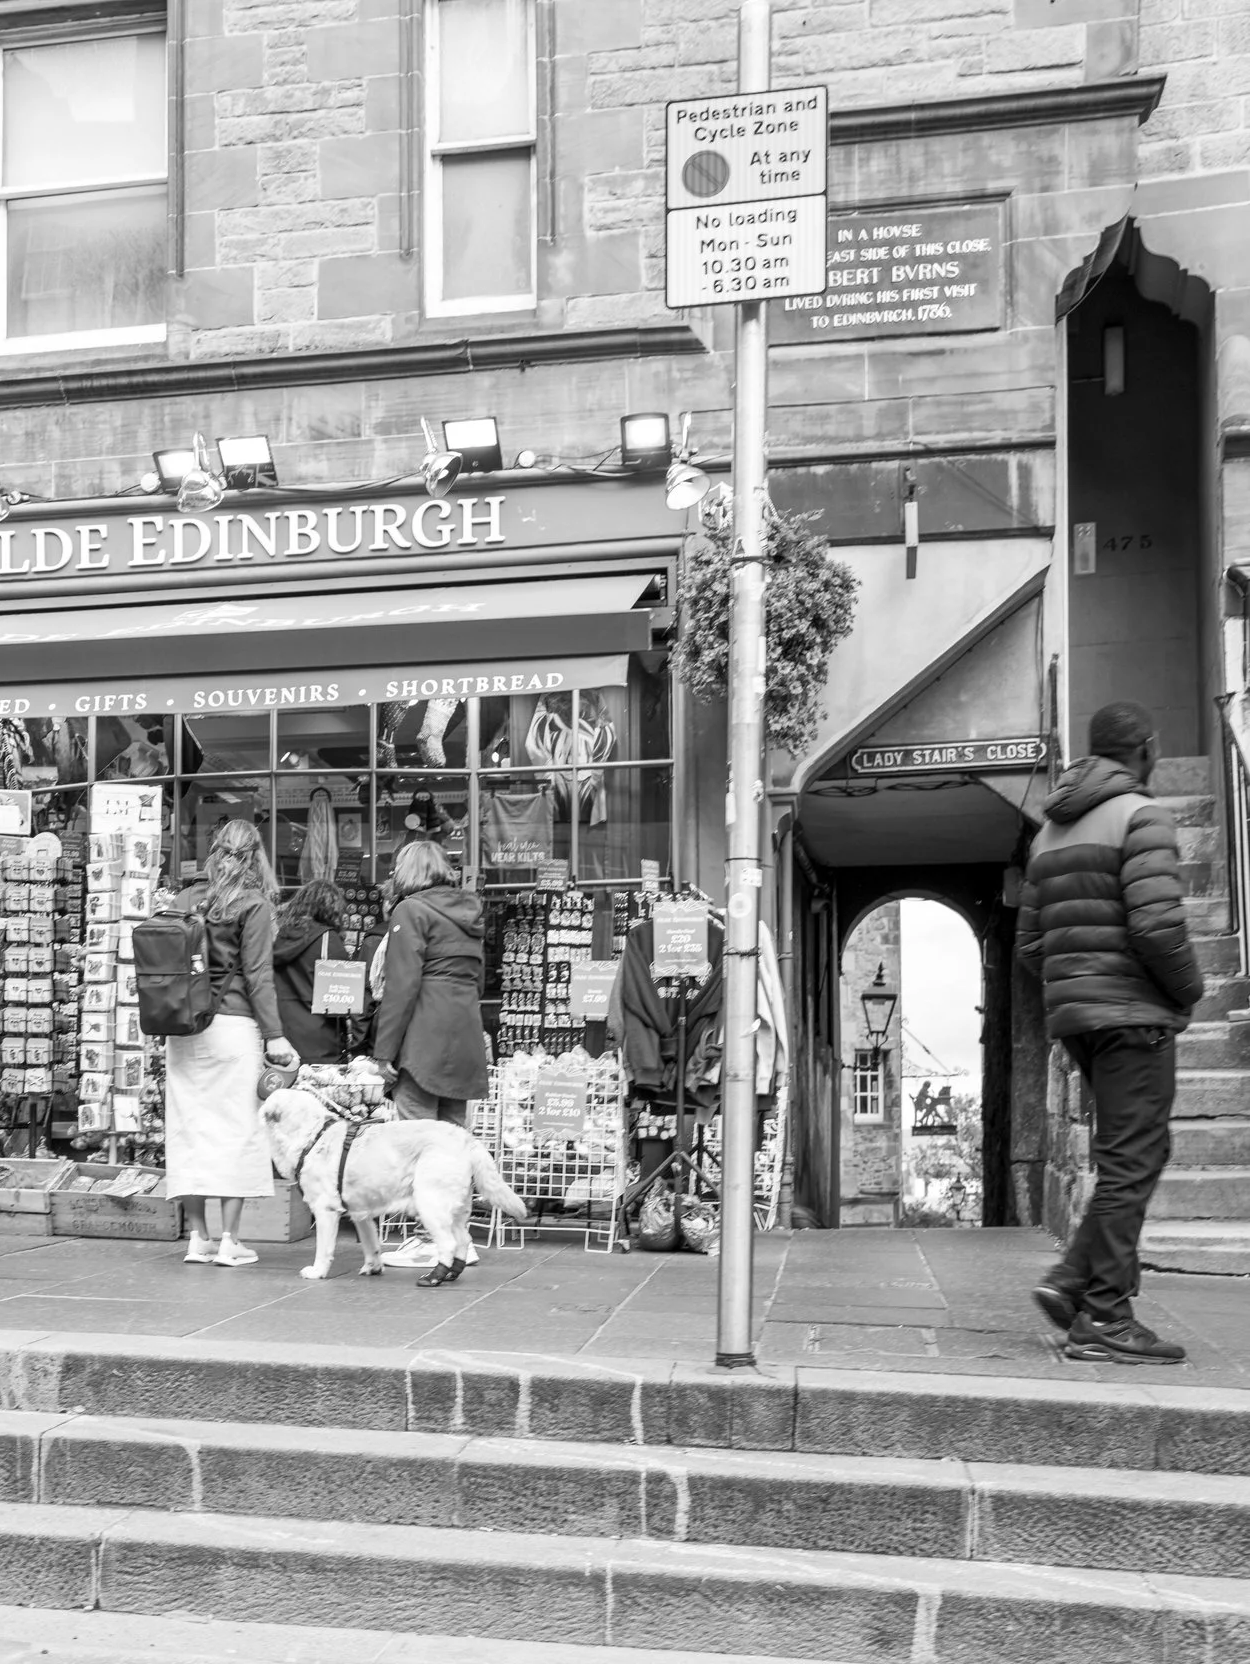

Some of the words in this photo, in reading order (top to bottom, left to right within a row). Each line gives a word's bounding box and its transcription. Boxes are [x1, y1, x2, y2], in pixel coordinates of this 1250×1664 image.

[676, 101, 777, 124] Pedestrian
[783, 95, 818, 112] and
[693, 123, 746, 143] Cycle
[752, 120, 799, 136] Zone
[749, 150, 771, 166] At
[778, 149, 811, 164] any
[759, 168, 801, 185] time
[695, 214, 721, 230] No
[729, 208, 798, 227] loading
[699, 238, 739, 254] Mon
[756, 233, 793, 248] Sun
[837, 228, 853, 243] IN
[857, 228, 869, 242] A
[859, 246, 890, 262] SIDE
[892, 244, 911, 259] OF
[913, 241, 944, 257] THIS
[701, 256, 757, 276] 10.30
[762, 256, 790, 269] am
[828, 266, 883, 288] BERT
[890, 261, 961, 284] BVRNS
[712, 275, 757, 294] 6.30
[762, 275, 790, 289] am
[784, 295, 823, 311] LIVED
[876, 289, 900, 304] HIS
[902, 285, 941, 302] FIRST
[943, 283, 978, 298] VISIT
[810, 315, 830, 329] TO
[126, 495, 508, 569] EDINBURGH
[74, 692, 149, 713] GIFTS
[193, 682, 341, 709] SOUVENIRS
[385, 671, 565, 699] SHORTBREAD
[862, 751, 904, 768] LADY
[912, 746, 975, 766] STAIR'S
[985, 742, 1038, 760] CLOSE
[658, 943, 667, 954] 2
[667, 943, 683, 953] for
[538, 1105, 546, 1116] 2
